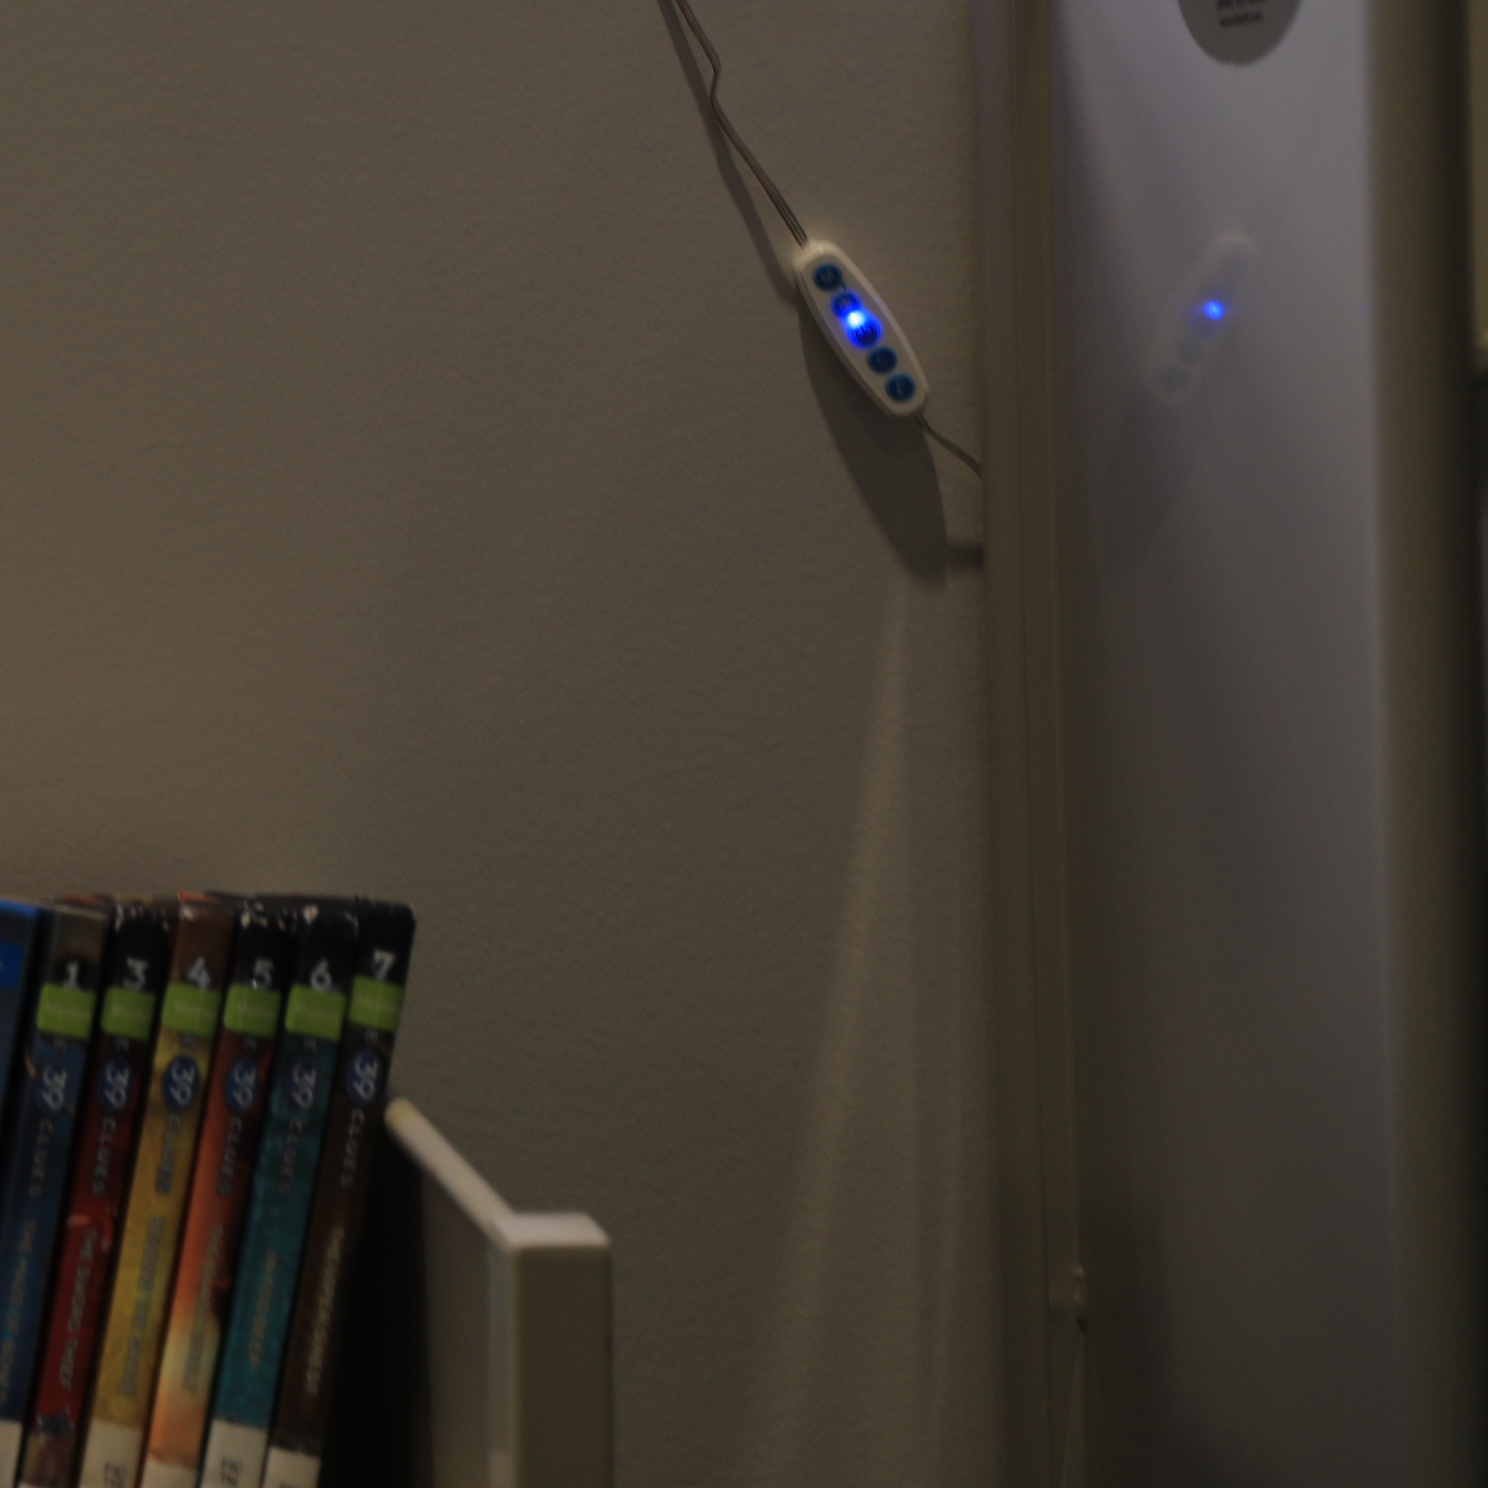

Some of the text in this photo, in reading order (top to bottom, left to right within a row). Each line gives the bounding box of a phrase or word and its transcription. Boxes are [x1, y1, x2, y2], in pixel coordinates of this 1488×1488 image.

[61, 959, 81, 988] 1
[121, 956, 150, 991] 3
[185, 955, 212, 990] 4
[250, 957, 275, 989] 5
[309, 957, 335, 992] 6
[370, 948, 397, 982] 7
[43, 1066, 67, 1110] 39
[108, 1062, 131, 1109] 39
[170, 1063, 194, 1107] 39
[233, 1063, 255, 1108] 39
[293, 1063, 316, 1110] 39
[355, 1051, 378, 1101] 39
